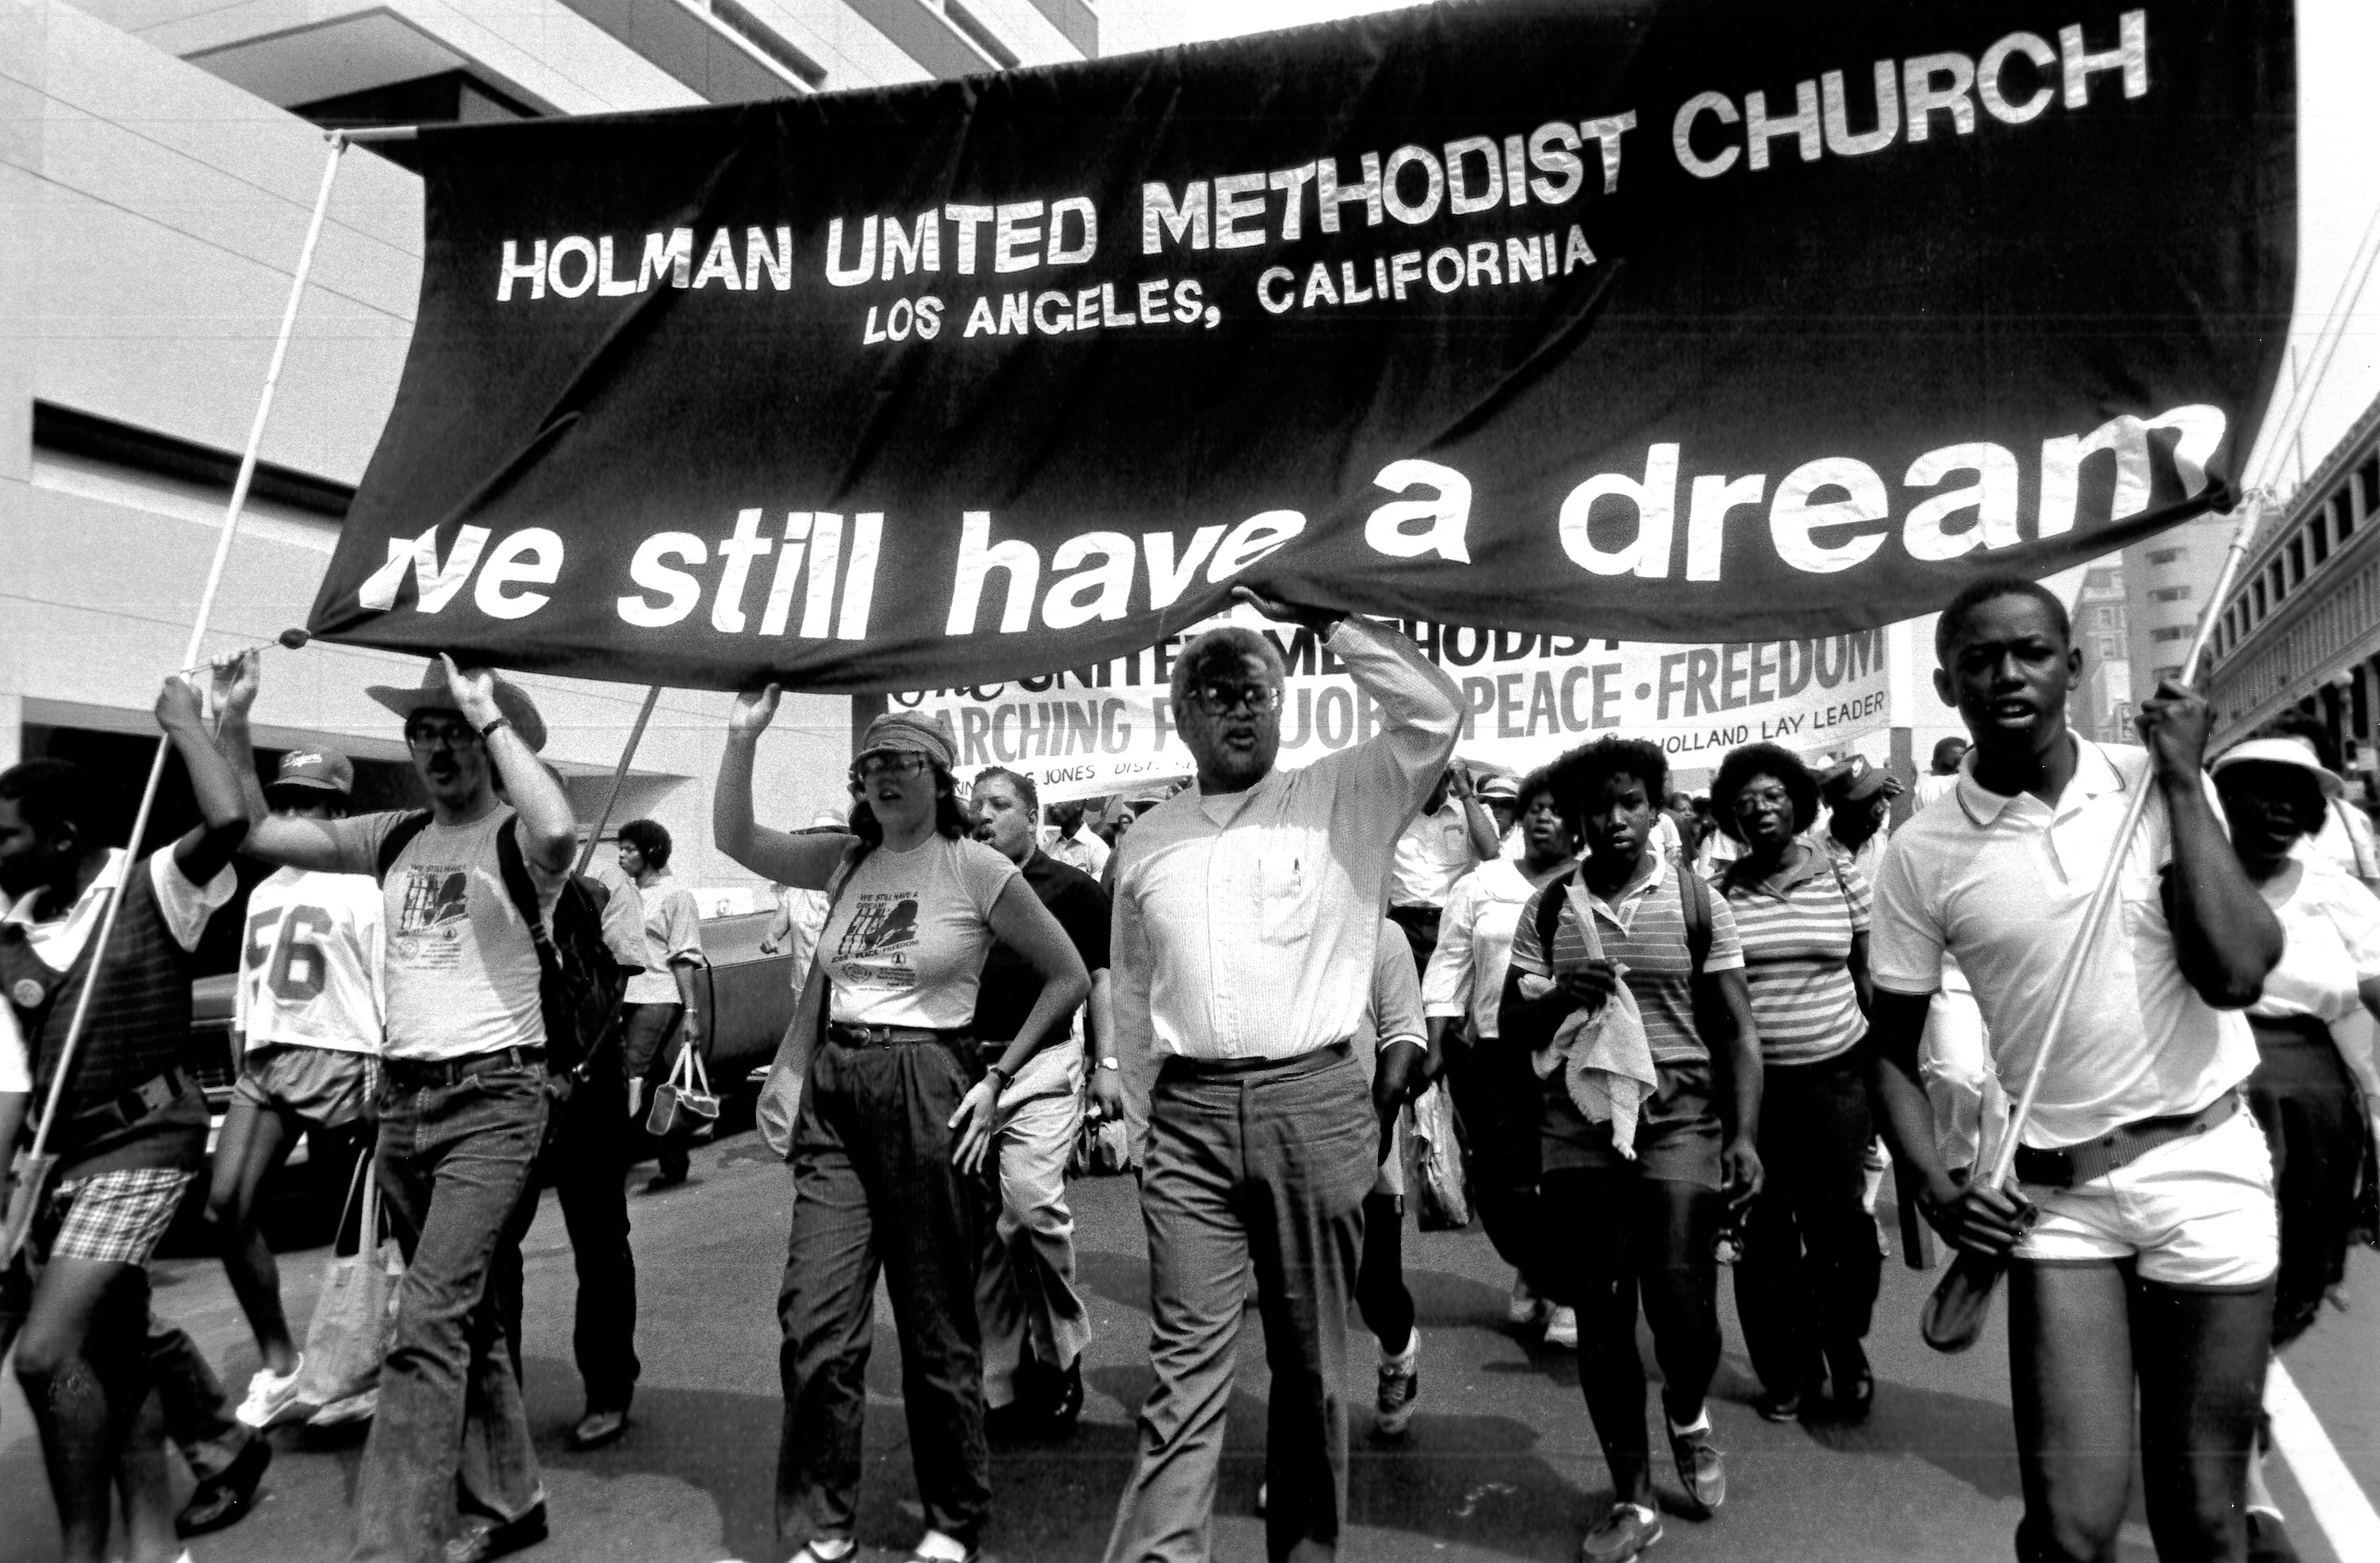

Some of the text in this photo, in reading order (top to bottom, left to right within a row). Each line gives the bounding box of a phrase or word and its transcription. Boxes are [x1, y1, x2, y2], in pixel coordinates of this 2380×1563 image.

[497, 10, 2148, 301] HOLMAN UNITED METHODIST CHURCH
[862, 225, 1596, 345] LOS ANGELES, CALIFORNIA
[616, 508, 885, 641] still
[945, 509, 1307, 638] have
[1364, 458, 1473, 565] a
[1557, 403, 2228, 582] dream
[935, 697, 1132, 768] ARCHING
[1461, 662, 1622, 741] PEACE
[1656, 627, 1883, 720] FREEDOM
[1761, 714, 1805, 740] LAY
[1814, 691, 1885, 729] LEADER
[1043, 765, 1096, 785] JONES
